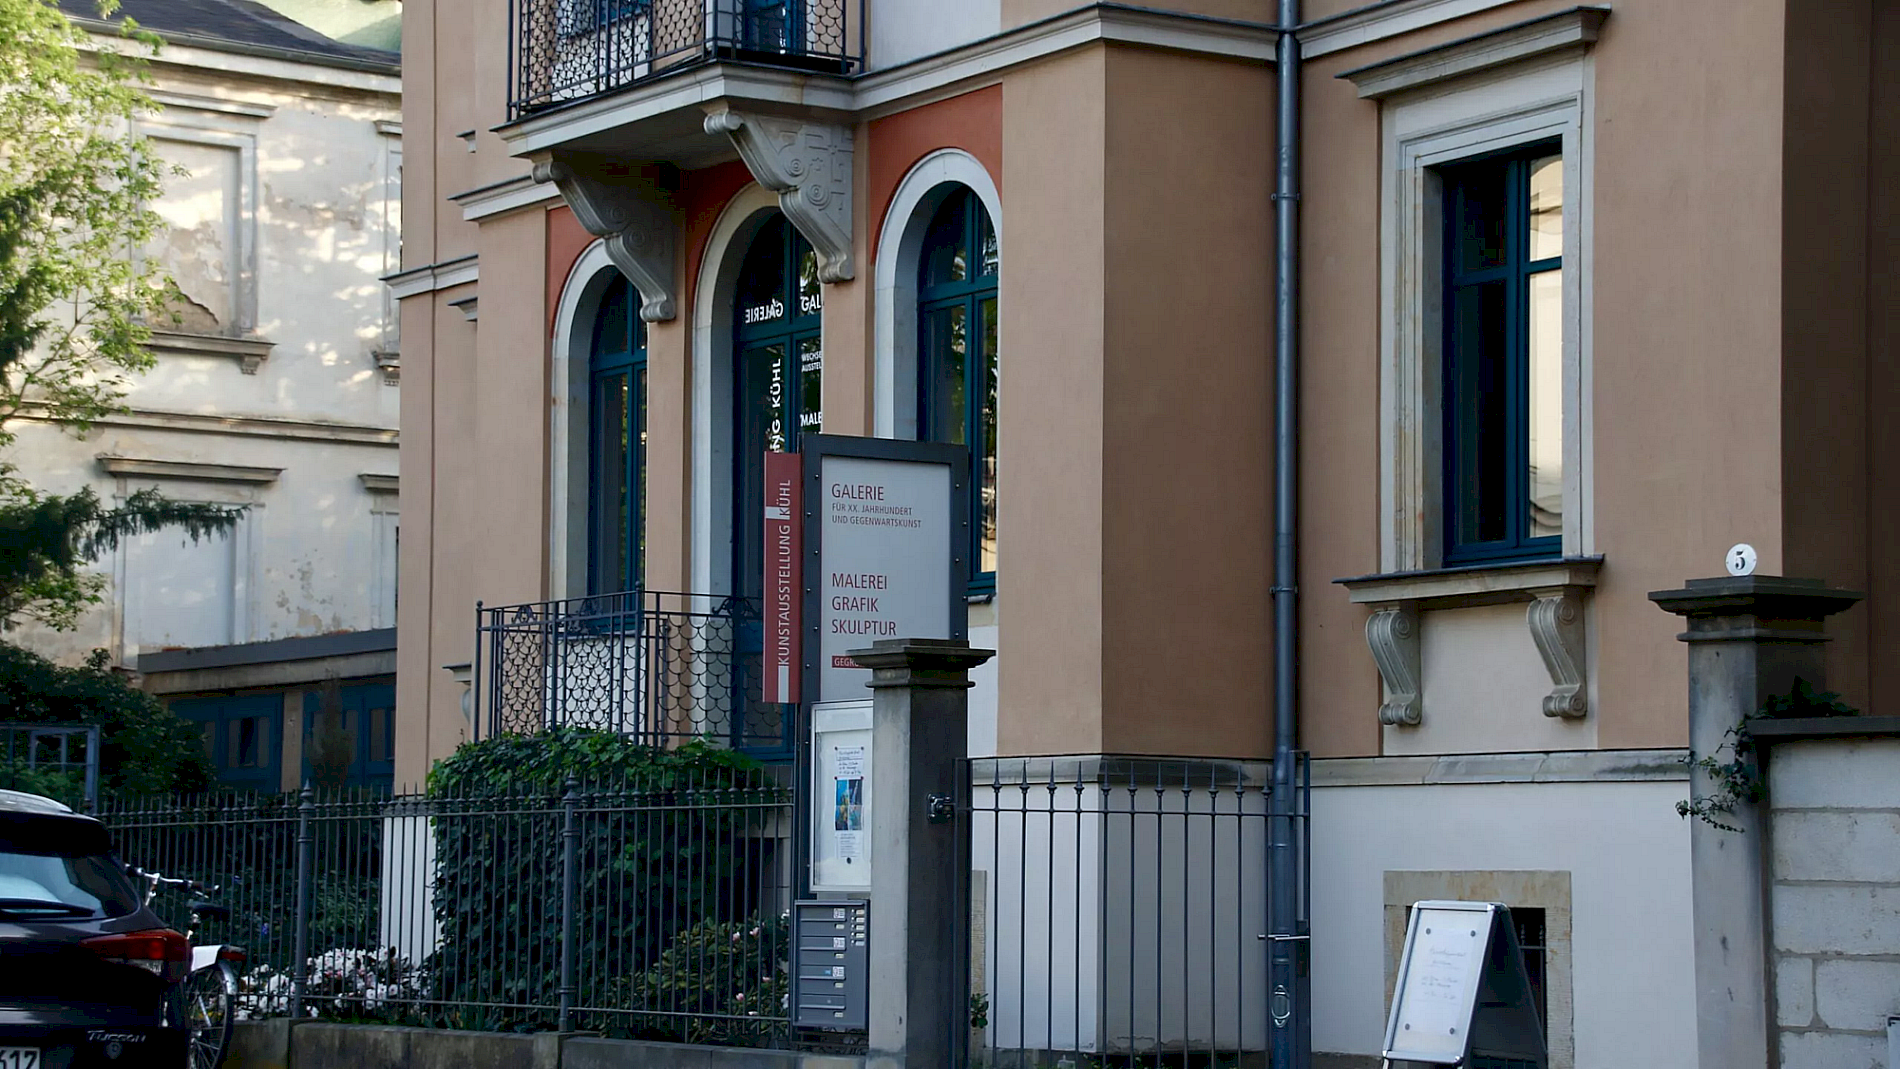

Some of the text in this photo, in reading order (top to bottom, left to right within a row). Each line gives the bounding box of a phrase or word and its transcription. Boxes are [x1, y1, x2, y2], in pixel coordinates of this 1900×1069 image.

[770, 358, 781, 408] KÜHL
[831, 483, 885, 501] GALERIE
[832, 502, 913, 516] FÜR XX. JAHRHUNDERT
[832, 515, 922, 529] UND GEGENWARTSKUNST
[1734, 550, 1746, 571] 5
[776, 479, 791, 666] KUNSTAUSSTELLUNG KÜHL
[832, 572, 888, 590] MALEREI
[831, 596, 879, 612] GRAFIK
[831, 618, 897, 636] SKULPTUR
